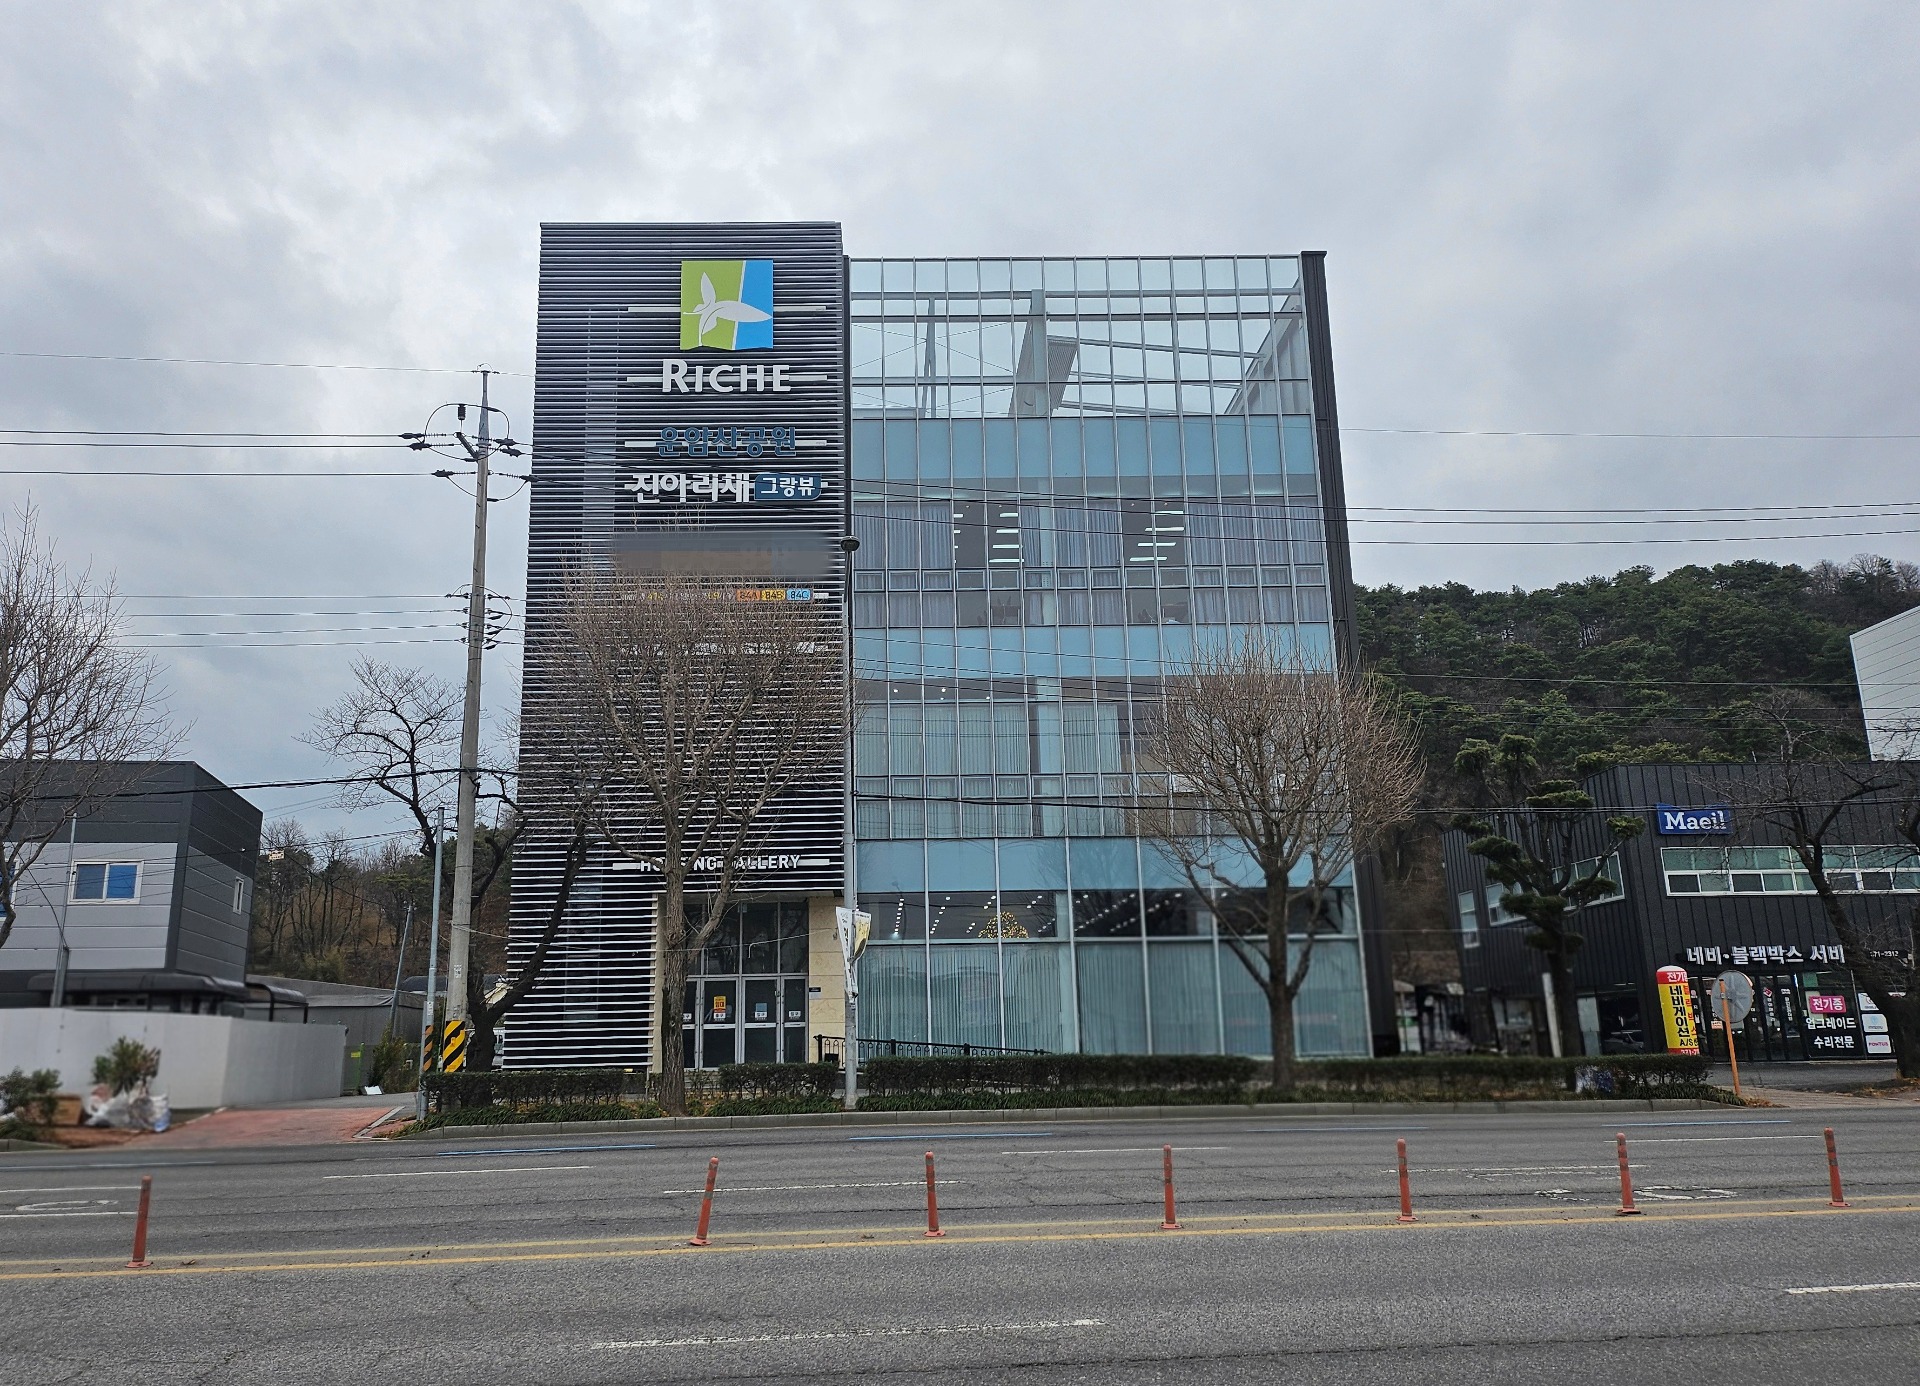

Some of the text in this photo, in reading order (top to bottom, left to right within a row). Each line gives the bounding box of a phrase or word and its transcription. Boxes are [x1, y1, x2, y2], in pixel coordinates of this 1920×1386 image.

[662, 359, 791, 393] RICHE
[655, 426, 797, 457] 운암산공원
[630, 472, 816, 504] 진아리채 그랑뷰
[790, 590, 809, 600] 84C
[1664, 810, 1727, 830] Maeil
[724, 855, 800, 870] ALLERY
[1809, 944, 1846, 964] 서비
[1669, 985, 1691, 1037] 네비게이션
[1812, 997, 1843, 1011] 전기종
[1805, 1016, 1857, 1030] 업그레이드
[1813, 1035, 1855, 1049] 수리전문
